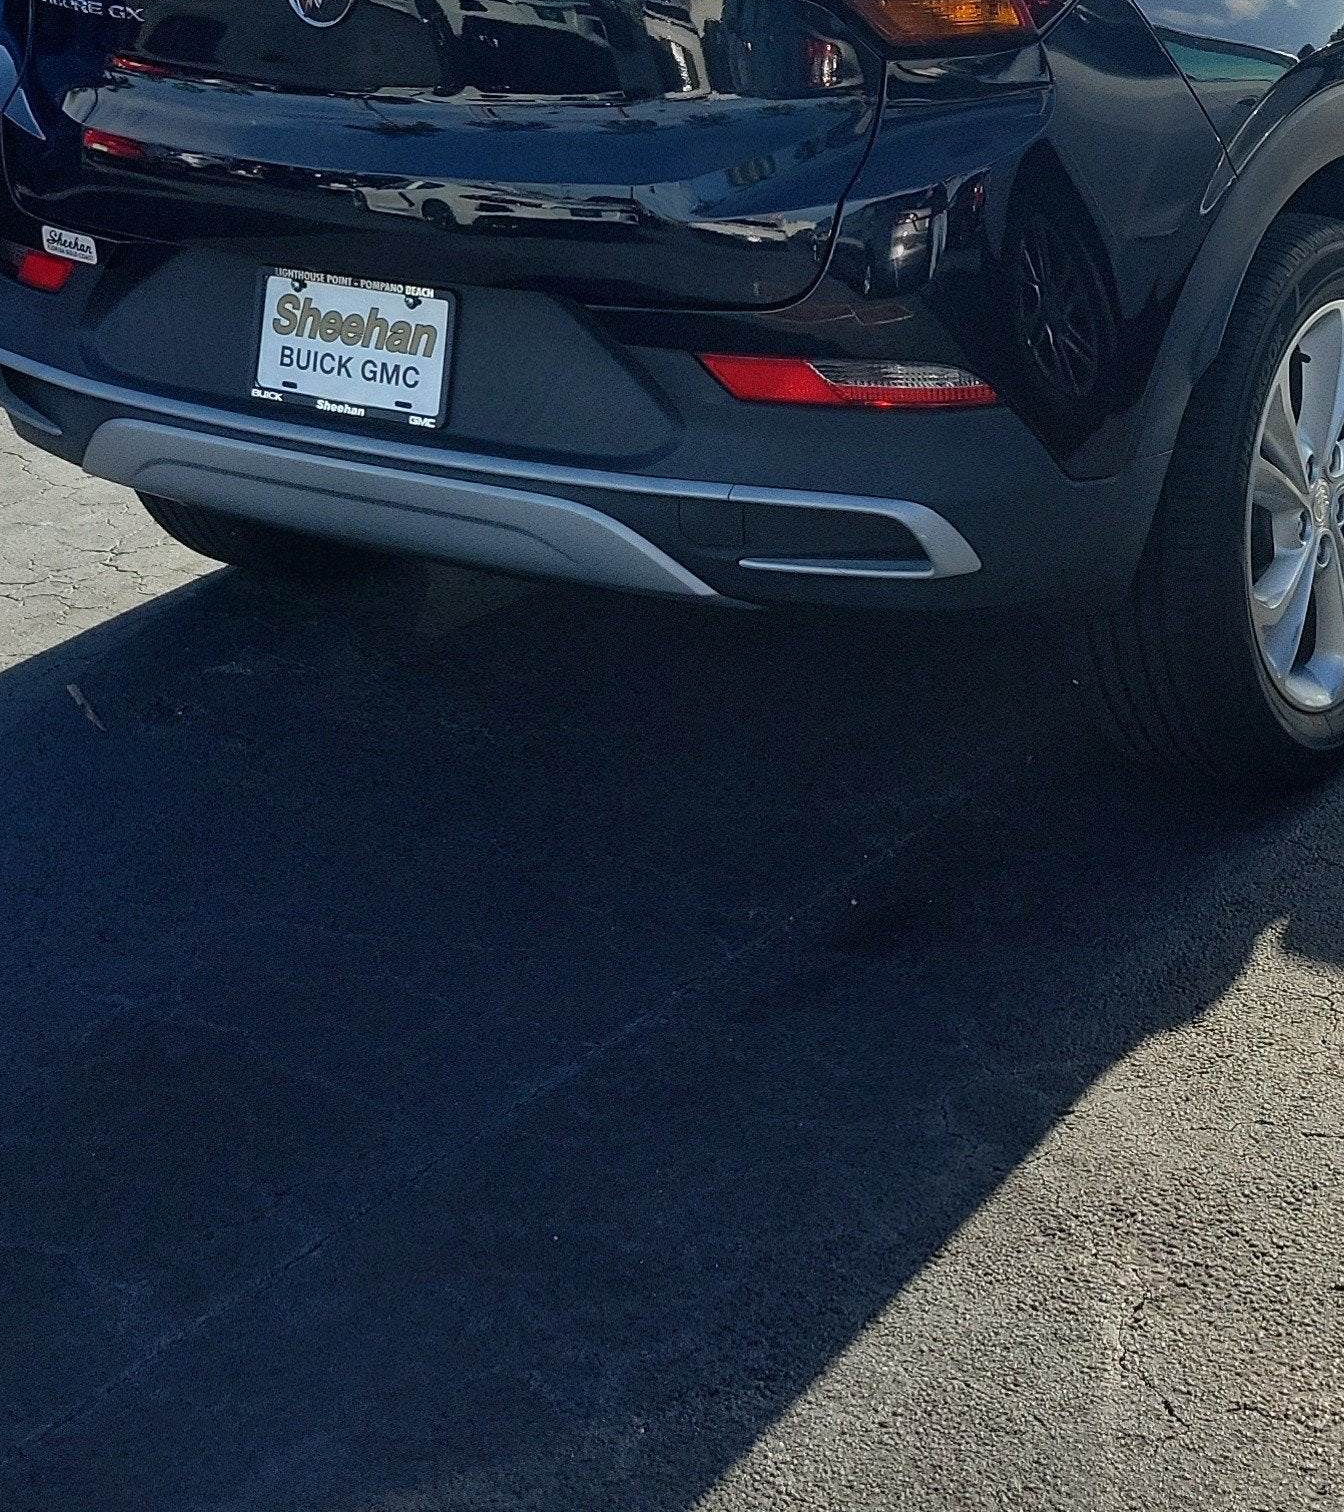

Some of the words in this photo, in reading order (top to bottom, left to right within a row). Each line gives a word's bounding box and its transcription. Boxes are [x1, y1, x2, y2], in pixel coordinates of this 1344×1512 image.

[108, 4, 146, 22] GX
[47, 230, 93, 254] Sheehan
[274, 267, 325, 284] LIGHTHOUSE
[326, 274, 352, 287] POINT
[360, 278, 404, 294] POMPANO
[405, 285, 435, 298] BEACH
[272, 293, 438, 358] Sheehan
[279, 345, 354, 379] BUICK
[360, 359, 420, 389] GMC
[251, 388, 283, 402] BUICK
[315, 399, 365, 417] Sheehan
[408, 415, 436, 429] GMC
